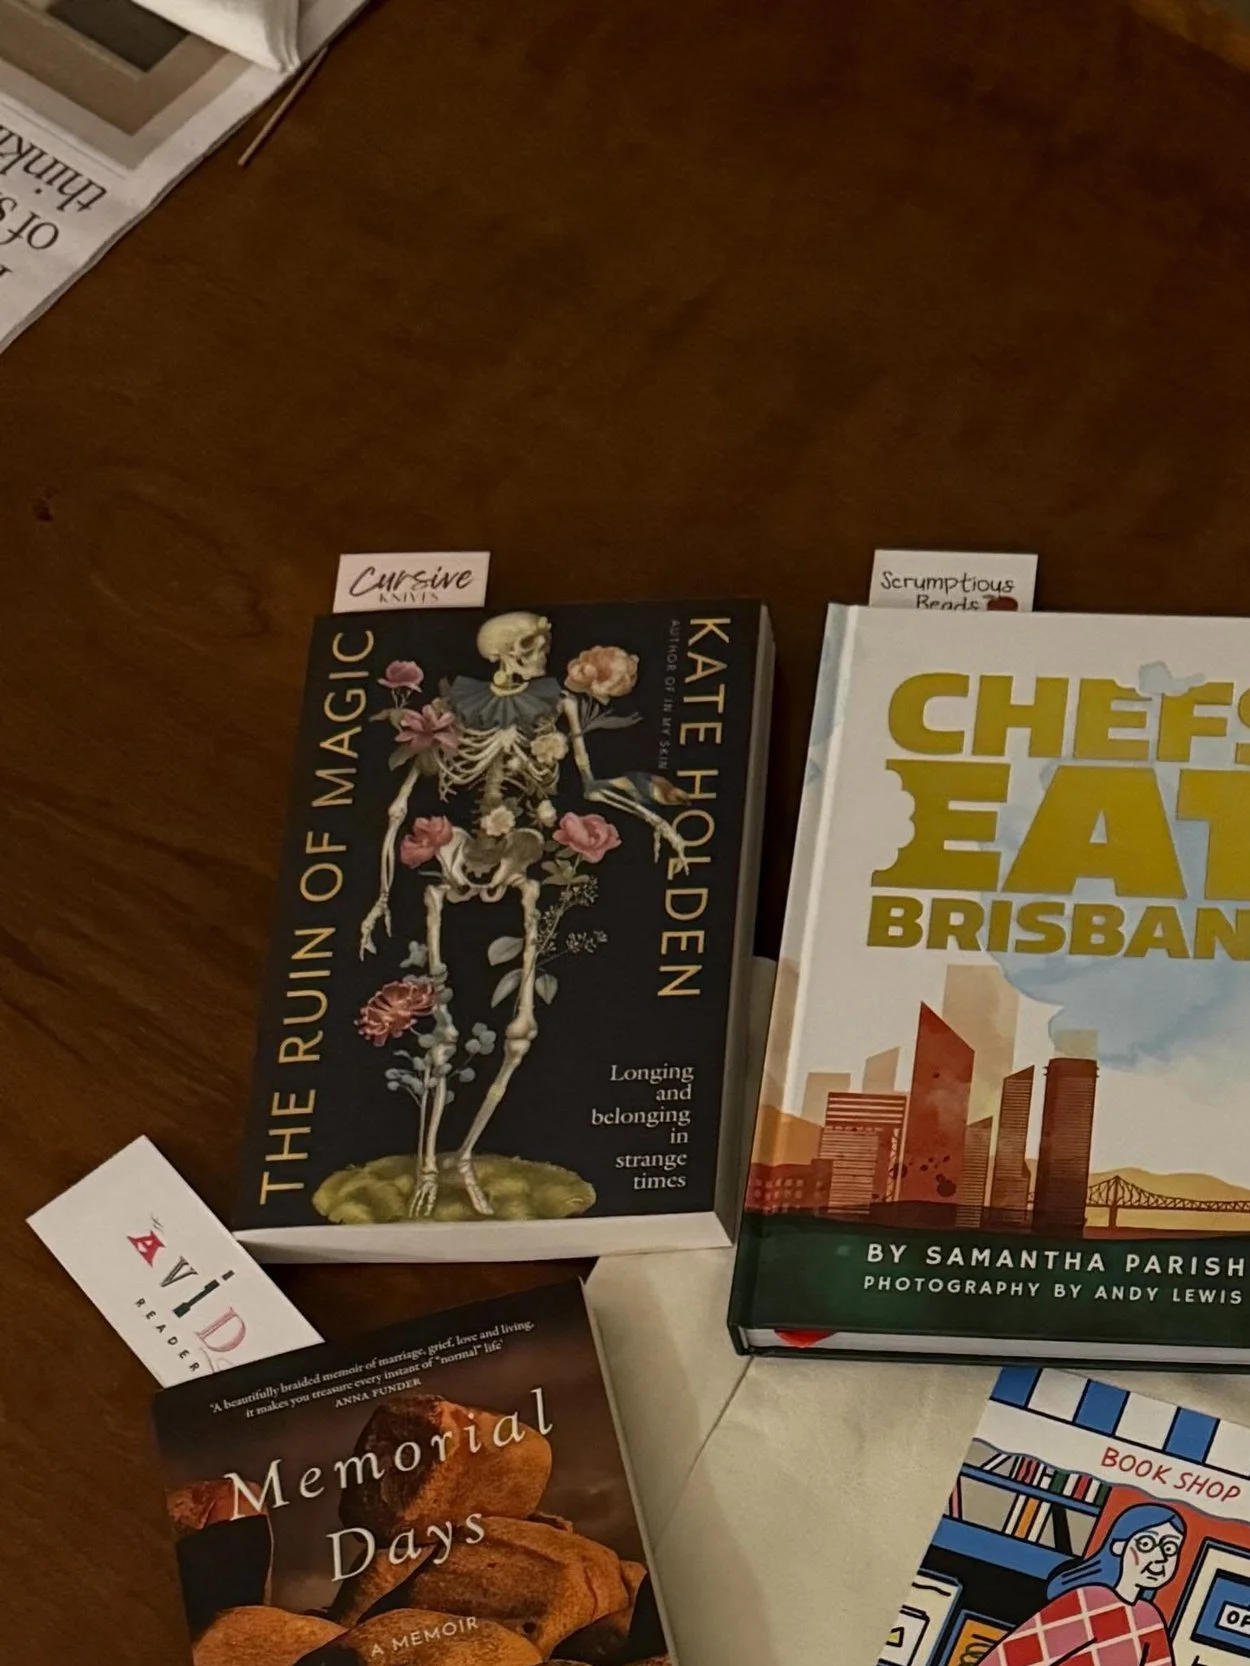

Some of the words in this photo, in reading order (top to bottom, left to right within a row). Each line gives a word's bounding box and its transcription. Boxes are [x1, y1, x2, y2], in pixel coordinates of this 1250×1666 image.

[0, 124, 107, 212] think
[349, 566, 473, 597] Cursive
[880, 570, 1015, 595] Scrumptious
[683, 617, 731, 746] KATE
[313, 629, 375, 807] MAGIC
[300, 830, 347, 902] OF
[657, 768, 720, 997] HOLDEN
[277, 926, 337, 1065] RUIN
[610, 1063, 695, 1085] Longing
[656, 1083, 692, 1102] and
[591, 1105, 691, 1127] belonging
[669, 1127, 689, 1145] in
[259, 1088, 316, 1204] THE
[614, 1149, 688, 1173] strange
[633, 1171, 687, 1191] times
[866, 1242, 907, 1264] BY
[925, 1244, 1106, 1273] SAMANTHA
[1123, 1252, 1246, 1279] PARISH
[862, 1275, 1042, 1299] PHOTOGRAPHY
[1053, 1282, 1082, 1300] BY
[1093, 1284, 1160, 1304] ANDY
[1172, 1286, 1244, 1306] LEWIS
[134, 1297, 201, 1373] READER
[223, 1386, 279, 1409] beautifully
[280, 1373, 321, 1393] braided
[322, 1364, 364, 1381] memoir
[364, 1357, 377, 1370] of
[378, 1348, 427, 1367] marriage,
[455, 1334, 478, 1345] love
[479, 1325, 500, 1339] and
[335, 1392, 370, 1408] ANNA
[372, 1378, 422, 1397] FUNDER
[224, 1387, 554, 1521] Memorial
[1100, 1446, 1171, 1485] BOOK
[1173, 1469, 1243, 1504] SHOP
[325, 1512, 486, 1583] Days
[370, 1645, 384, 1659] A
[391, 1615, 479, 1652] MEMOIR
